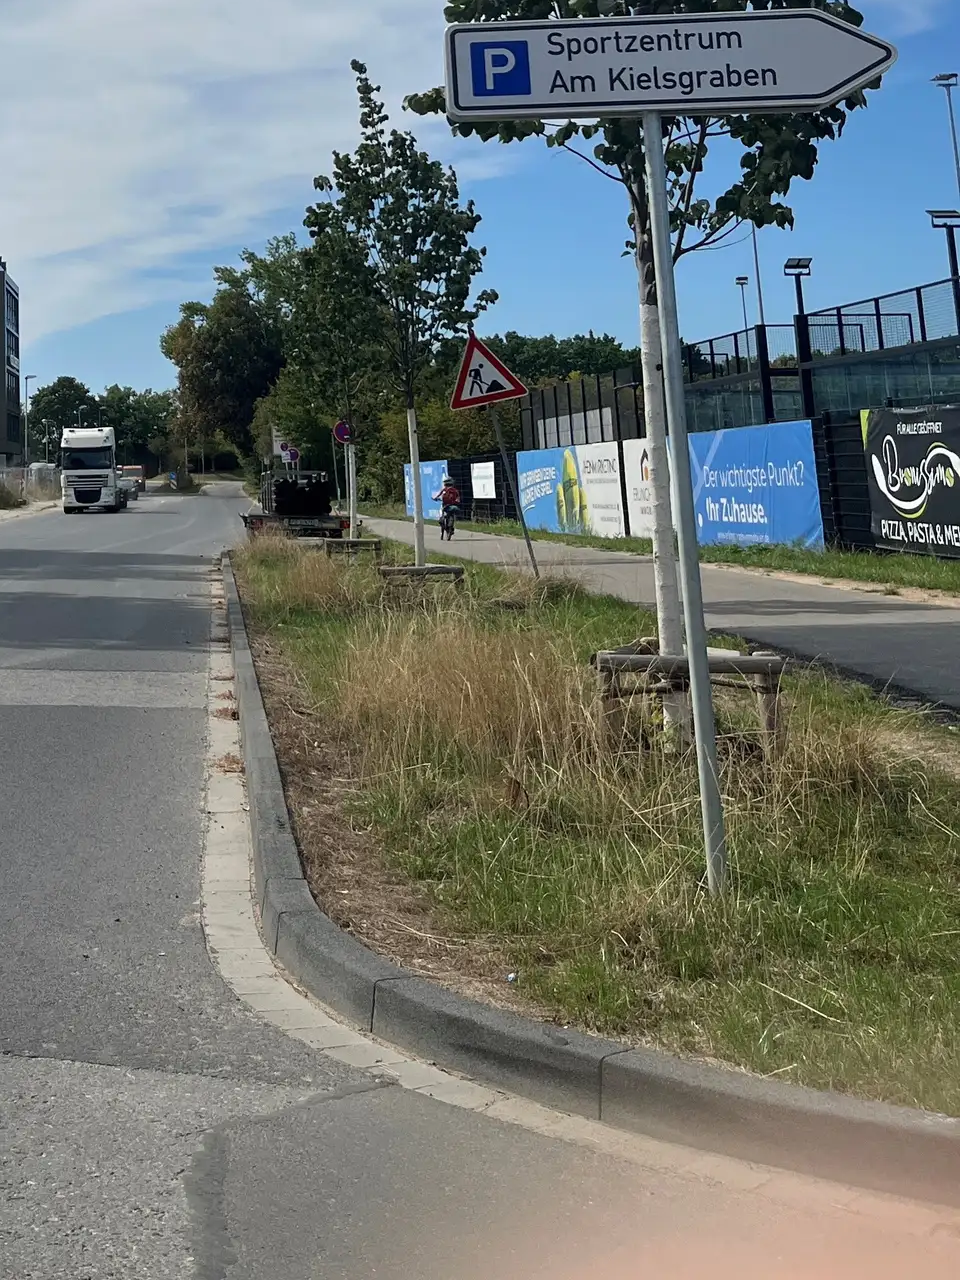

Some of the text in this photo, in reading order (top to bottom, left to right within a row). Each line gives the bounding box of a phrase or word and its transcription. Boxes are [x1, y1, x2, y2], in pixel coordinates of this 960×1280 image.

[547, 29, 742, 61] Sportzentrum
[483, 47, 516, 90] P
[549, 63, 778, 95] Am Kielsgraben
[703, 460, 804, 493] Der wichtigste Punkt?
[706, 496, 768, 524] Ihr Zuhause.
[881, 519, 908, 543] PIZZA,
[907, 520, 936, 543] PASTA
[936, 525, 944, 544] &
